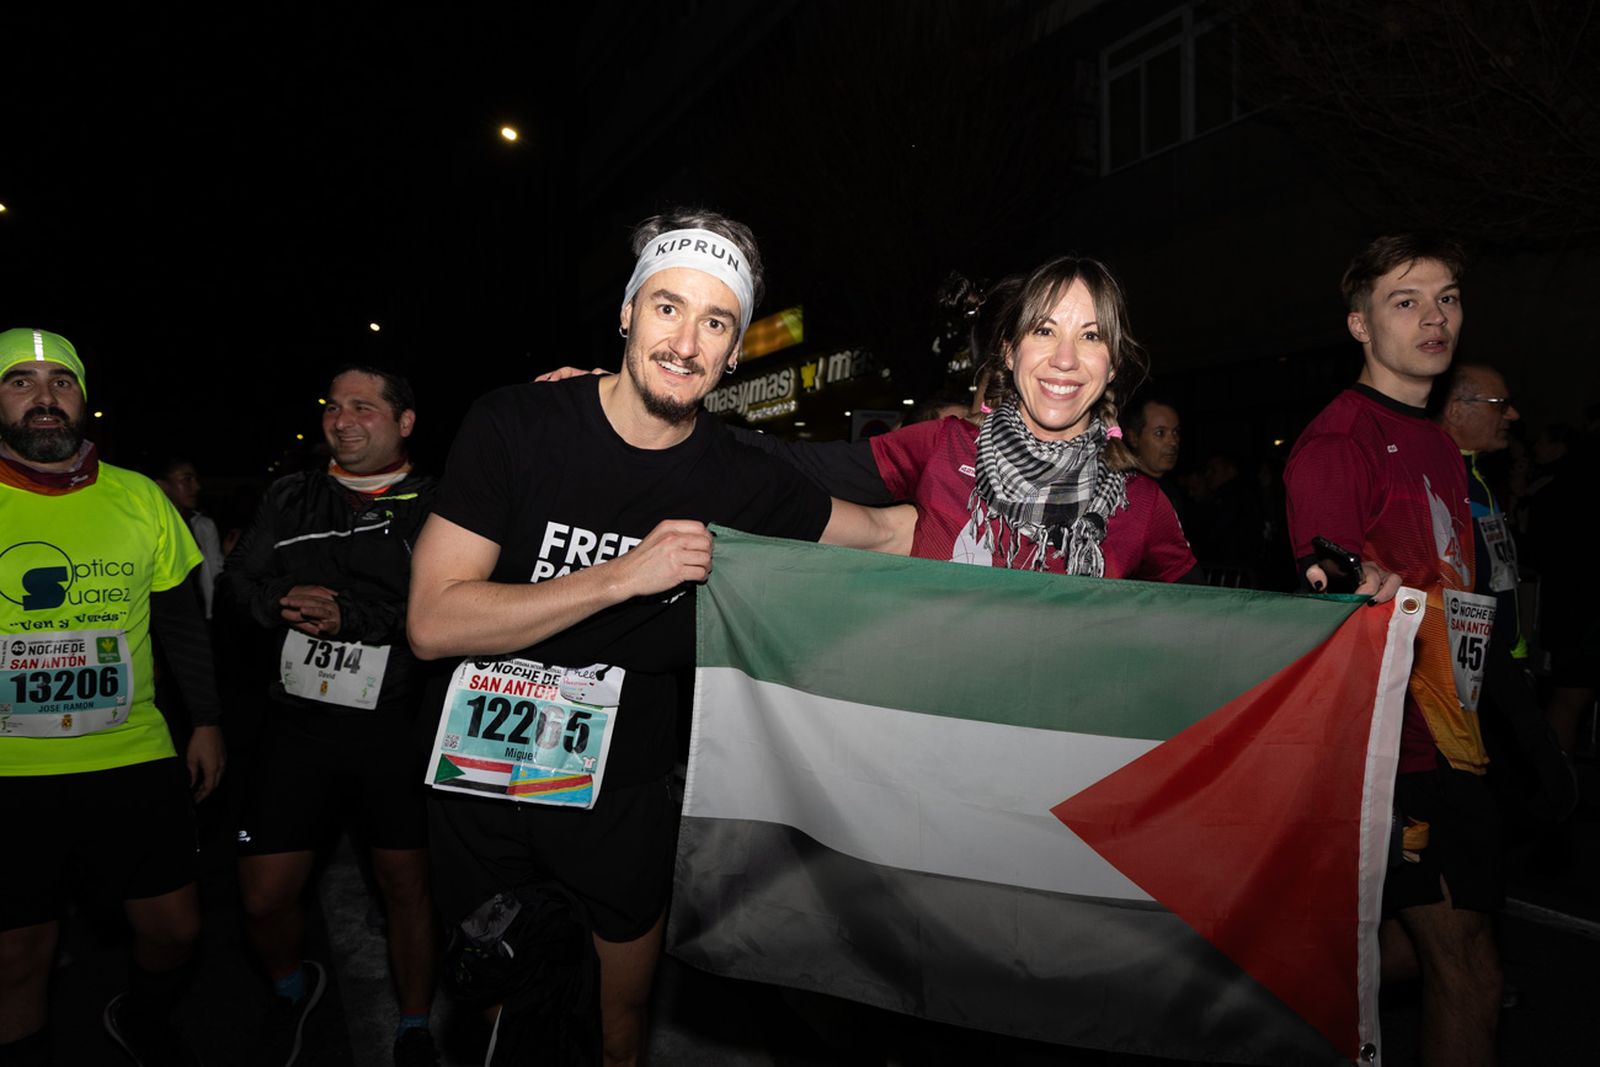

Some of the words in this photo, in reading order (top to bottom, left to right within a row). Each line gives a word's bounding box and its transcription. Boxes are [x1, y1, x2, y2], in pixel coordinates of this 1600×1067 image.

[656, 239, 739, 271] KIPRUN
[1459, 606, 1488, 620] NOCHE
[59, 619, 69, 628] y
[1451, 618, 1465, 633] SAN
[28, 644, 69, 655] NOCHE
[71, 643, 85, 653] DE
[303, 639, 362, 674] 7314
[10, 658, 38, 670] SAN
[491, 662, 541, 683] NOCHE
[541, 672, 561, 686] DE
[10, 666, 119, 703] 13206
[469, 675, 502, 693] SAN
[38, 703, 62, 713] JOSE
